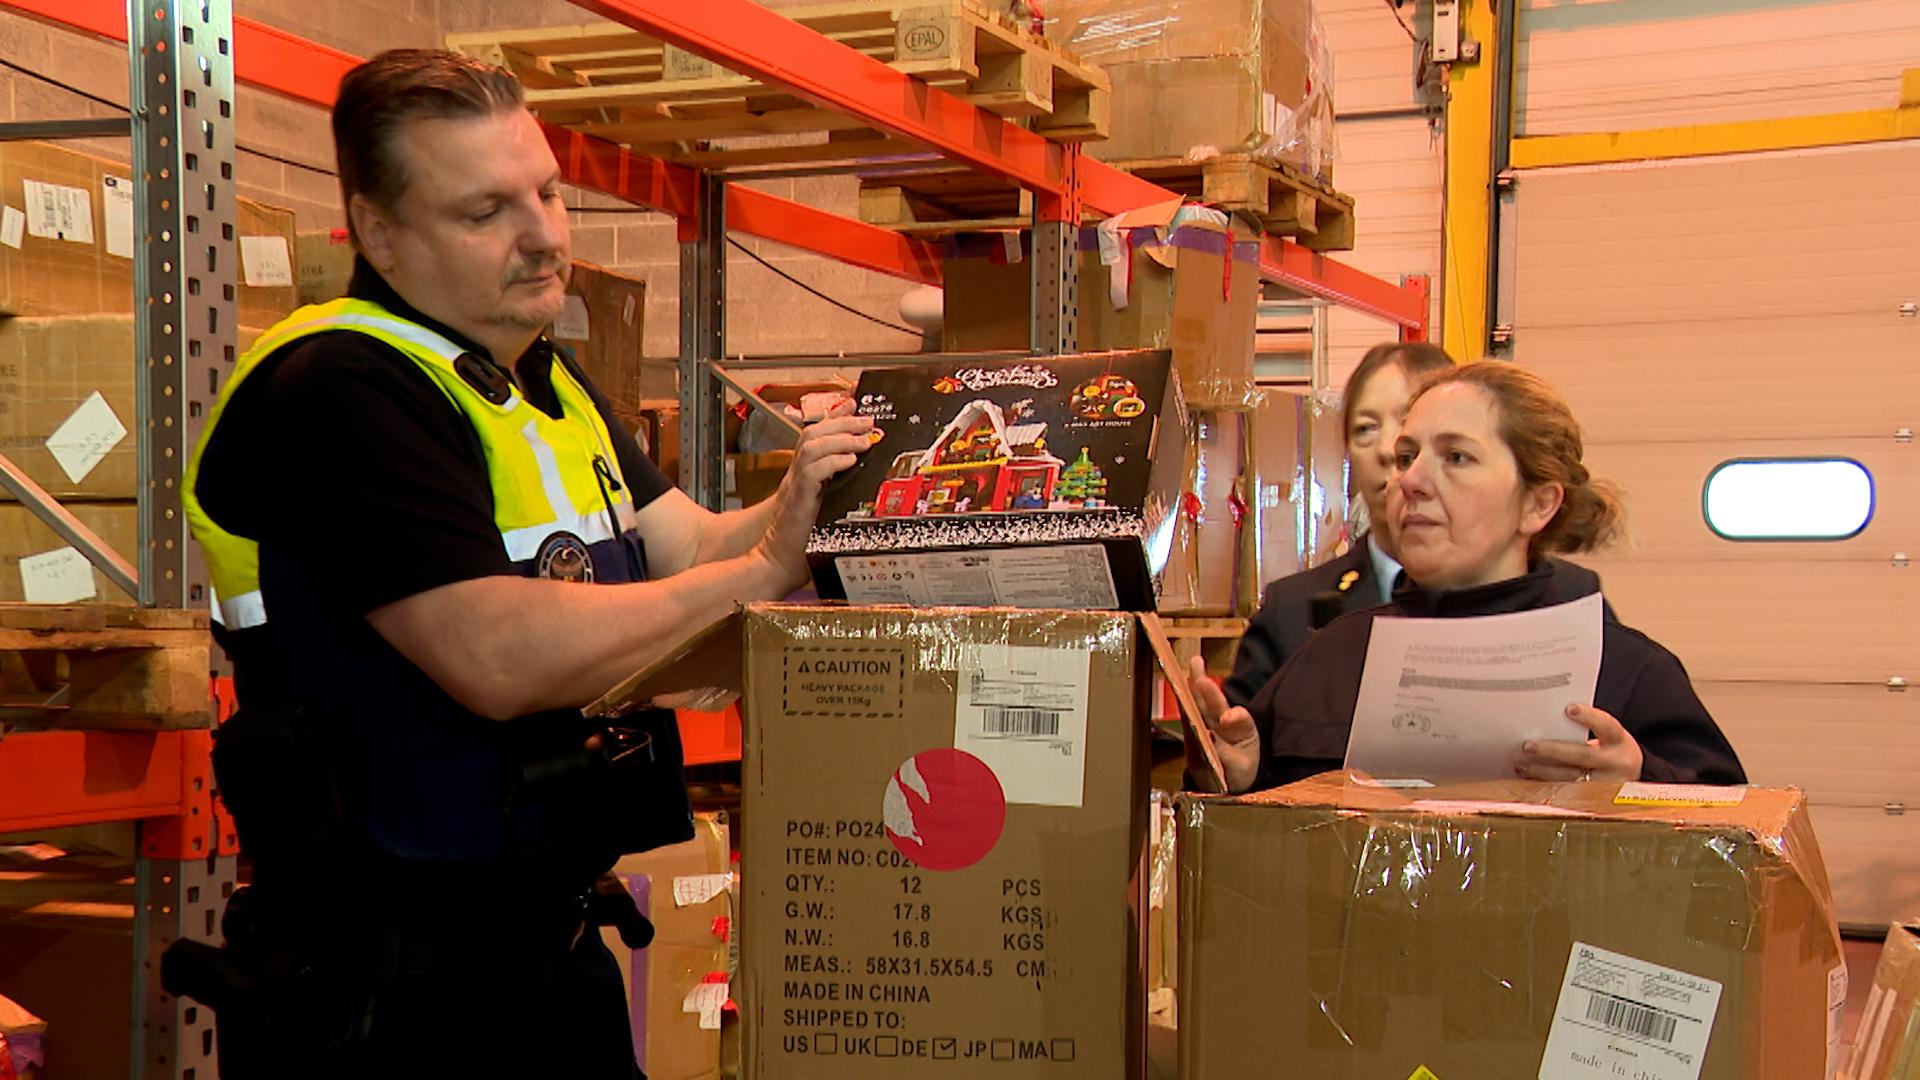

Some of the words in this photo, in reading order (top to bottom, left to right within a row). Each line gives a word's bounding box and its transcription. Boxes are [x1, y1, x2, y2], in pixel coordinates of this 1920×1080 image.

[911, 31, 938, 47] EPAL
[815, 660, 891, 675] CAUTION
[801, 683, 834, 692] HEAVY
[837, 684, 885, 694] PACKAGE
[816, 696, 844, 704] OVER
[786, 821, 830, 839] PO#:
[836, 821, 885, 839] PO24
[786, 848, 831, 865] ITEM
[837, 848, 871, 866] NO:
[876, 850, 919, 868] C02
[785, 874, 834, 893] QTY.:
[900, 876, 922, 894] 12
[1002, 879, 1041, 896] PCS
[785, 901, 834, 919] G.W.:
[893, 903, 930, 921] 17.8
[1001, 906, 1042, 924] KGS
[785, 928, 832, 946] N.W.:
[893, 930, 930, 948] 16.8
[1003, 933, 1044, 950] KGS
[784, 954, 851, 974] MEAS.:
[866, 956, 993, 977] 58X31.5X54.5
[1016, 960, 1045, 977] CM
[784, 982, 839, 1001] MADE
[845, 983, 863, 1001] IN
[869, 983, 930, 1003] CHINA
[784, 1008, 868, 1028] SHIPPED
[874, 1011, 905, 1029] TO:
[784, 1035, 808, 1053] US
[845, 1038, 871, 1055] UK
[902, 1040, 927, 1057] DE
[963, 1040, 987, 1057] JP
[1019, 1040, 1048, 1059] MA
[1570, 1052, 1602, 1068] made
[1612, 1062, 1625, 1076] in
